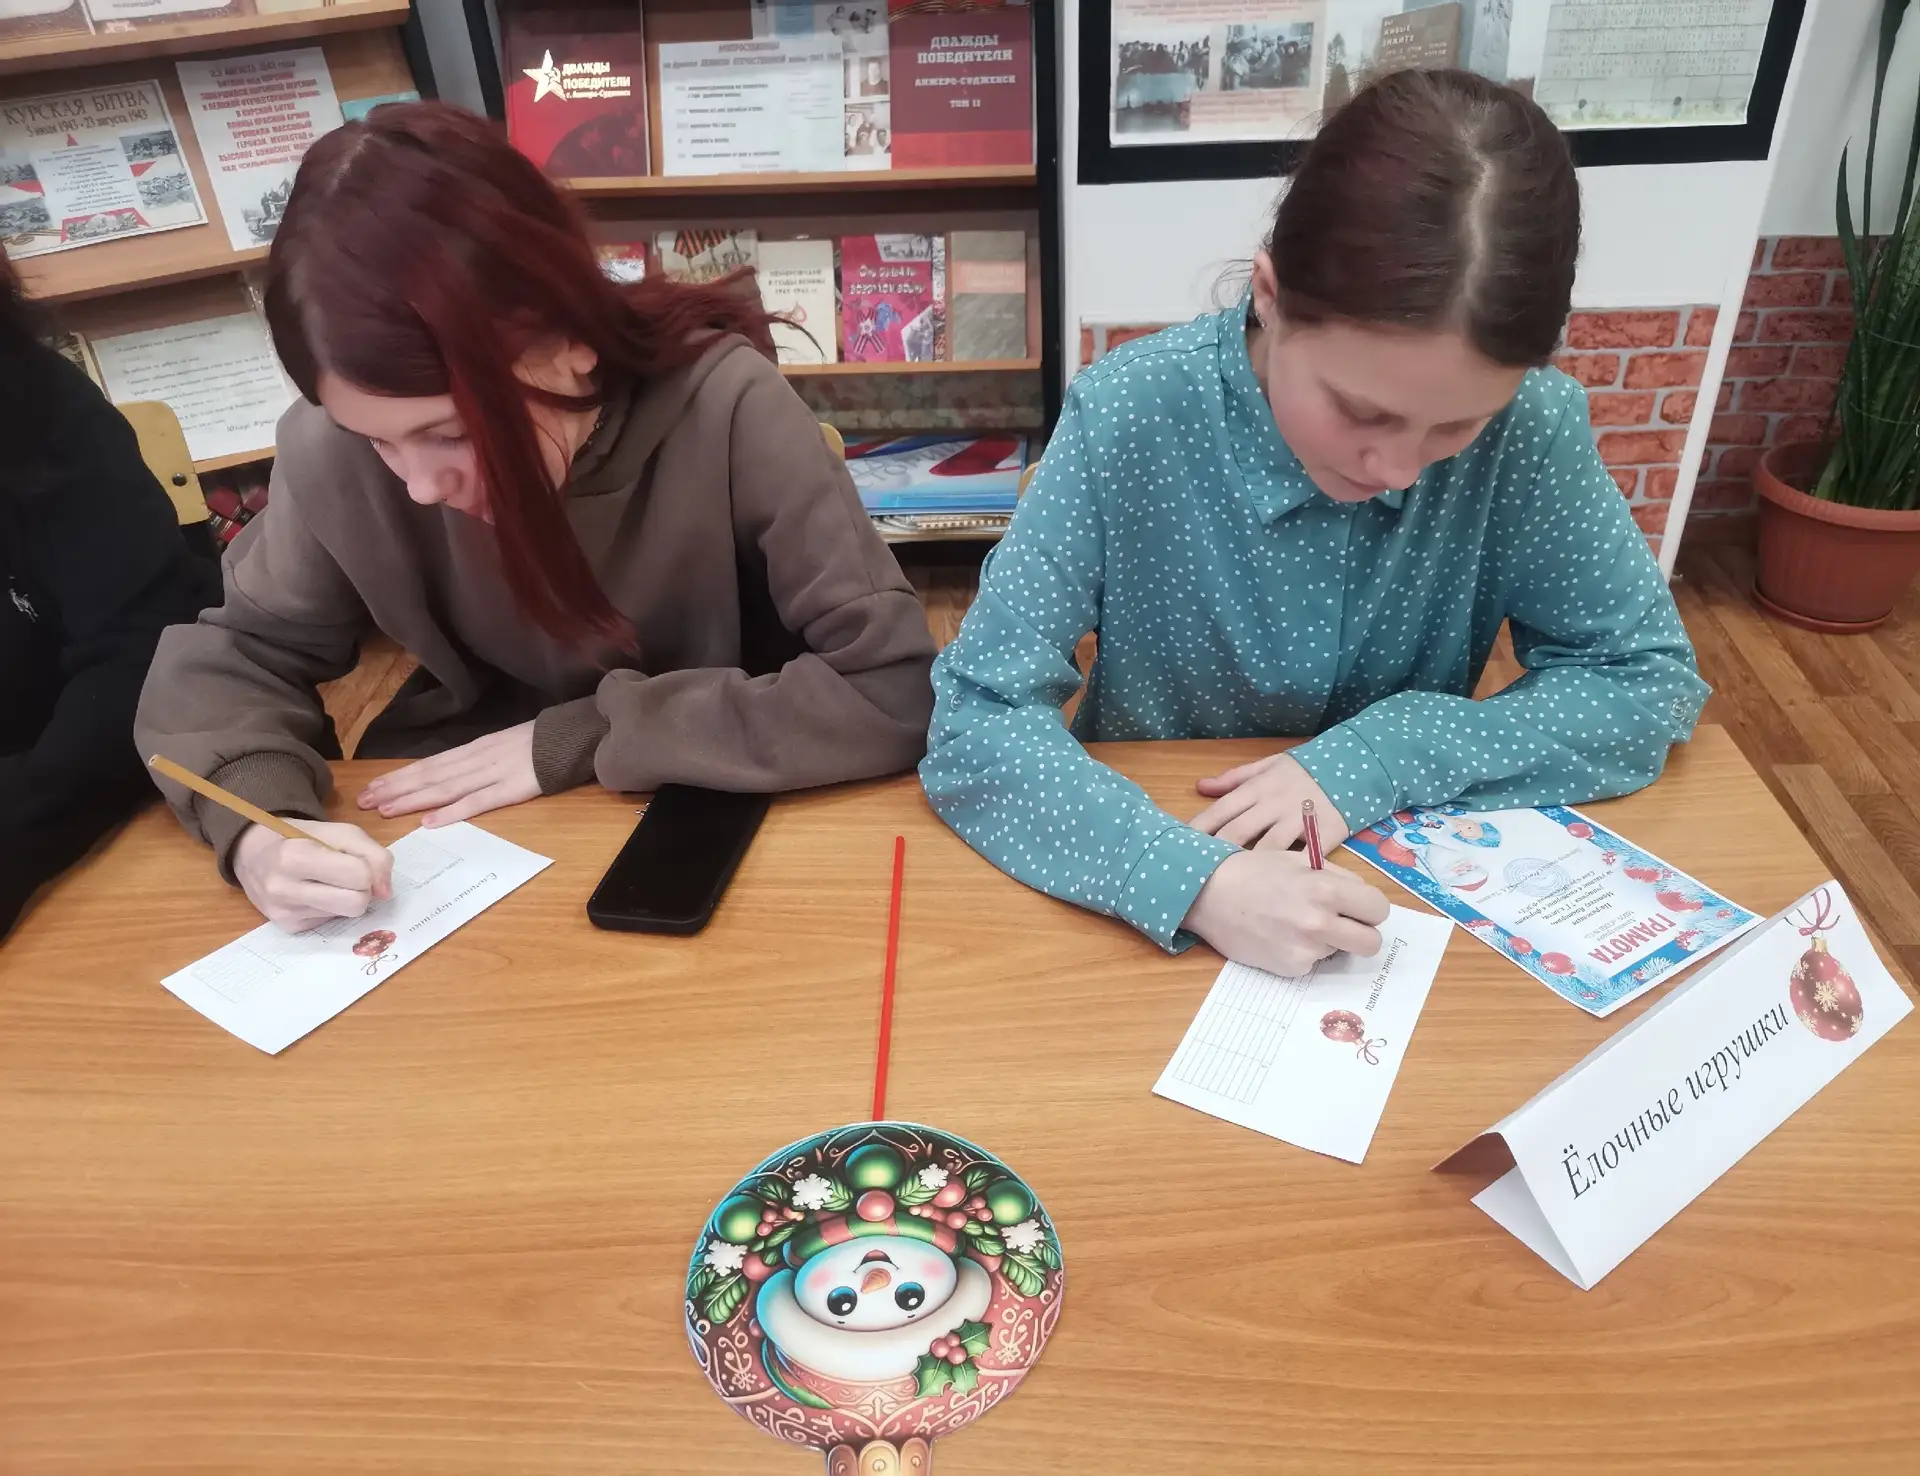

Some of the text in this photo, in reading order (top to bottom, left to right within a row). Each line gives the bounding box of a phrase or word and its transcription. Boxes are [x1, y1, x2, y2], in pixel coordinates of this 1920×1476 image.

[931, 34, 999, 50] ДВАЖДЫ
[917, 49, 1013, 64] ПОБЕДИТЕЛИ
[562, 62, 610, 76] ДВАЖДЫ
[563, 76, 631, 90] ПОБЕДИТЕЛИ
[915, 75, 1016, 87] АНЖЕРО-СУДЖЕНСК
[3, 90, 150, 125] КУРСКАЯ БИТВА
[950, 99, 970, 108] ТОМ
[59, 118, 79, 132] 1943
[83, 115, 96, 129] 23
[128, 108, 149, 121] 1943
[409, 902, 452, 932] игрушки
[1587, 913, 1676, 964] ГРАМОТА
[1365, 936, 1408, 1012] Ёлочные игрушки
[1561, 1003, 1789, 1200] Ёлочные игрушки
